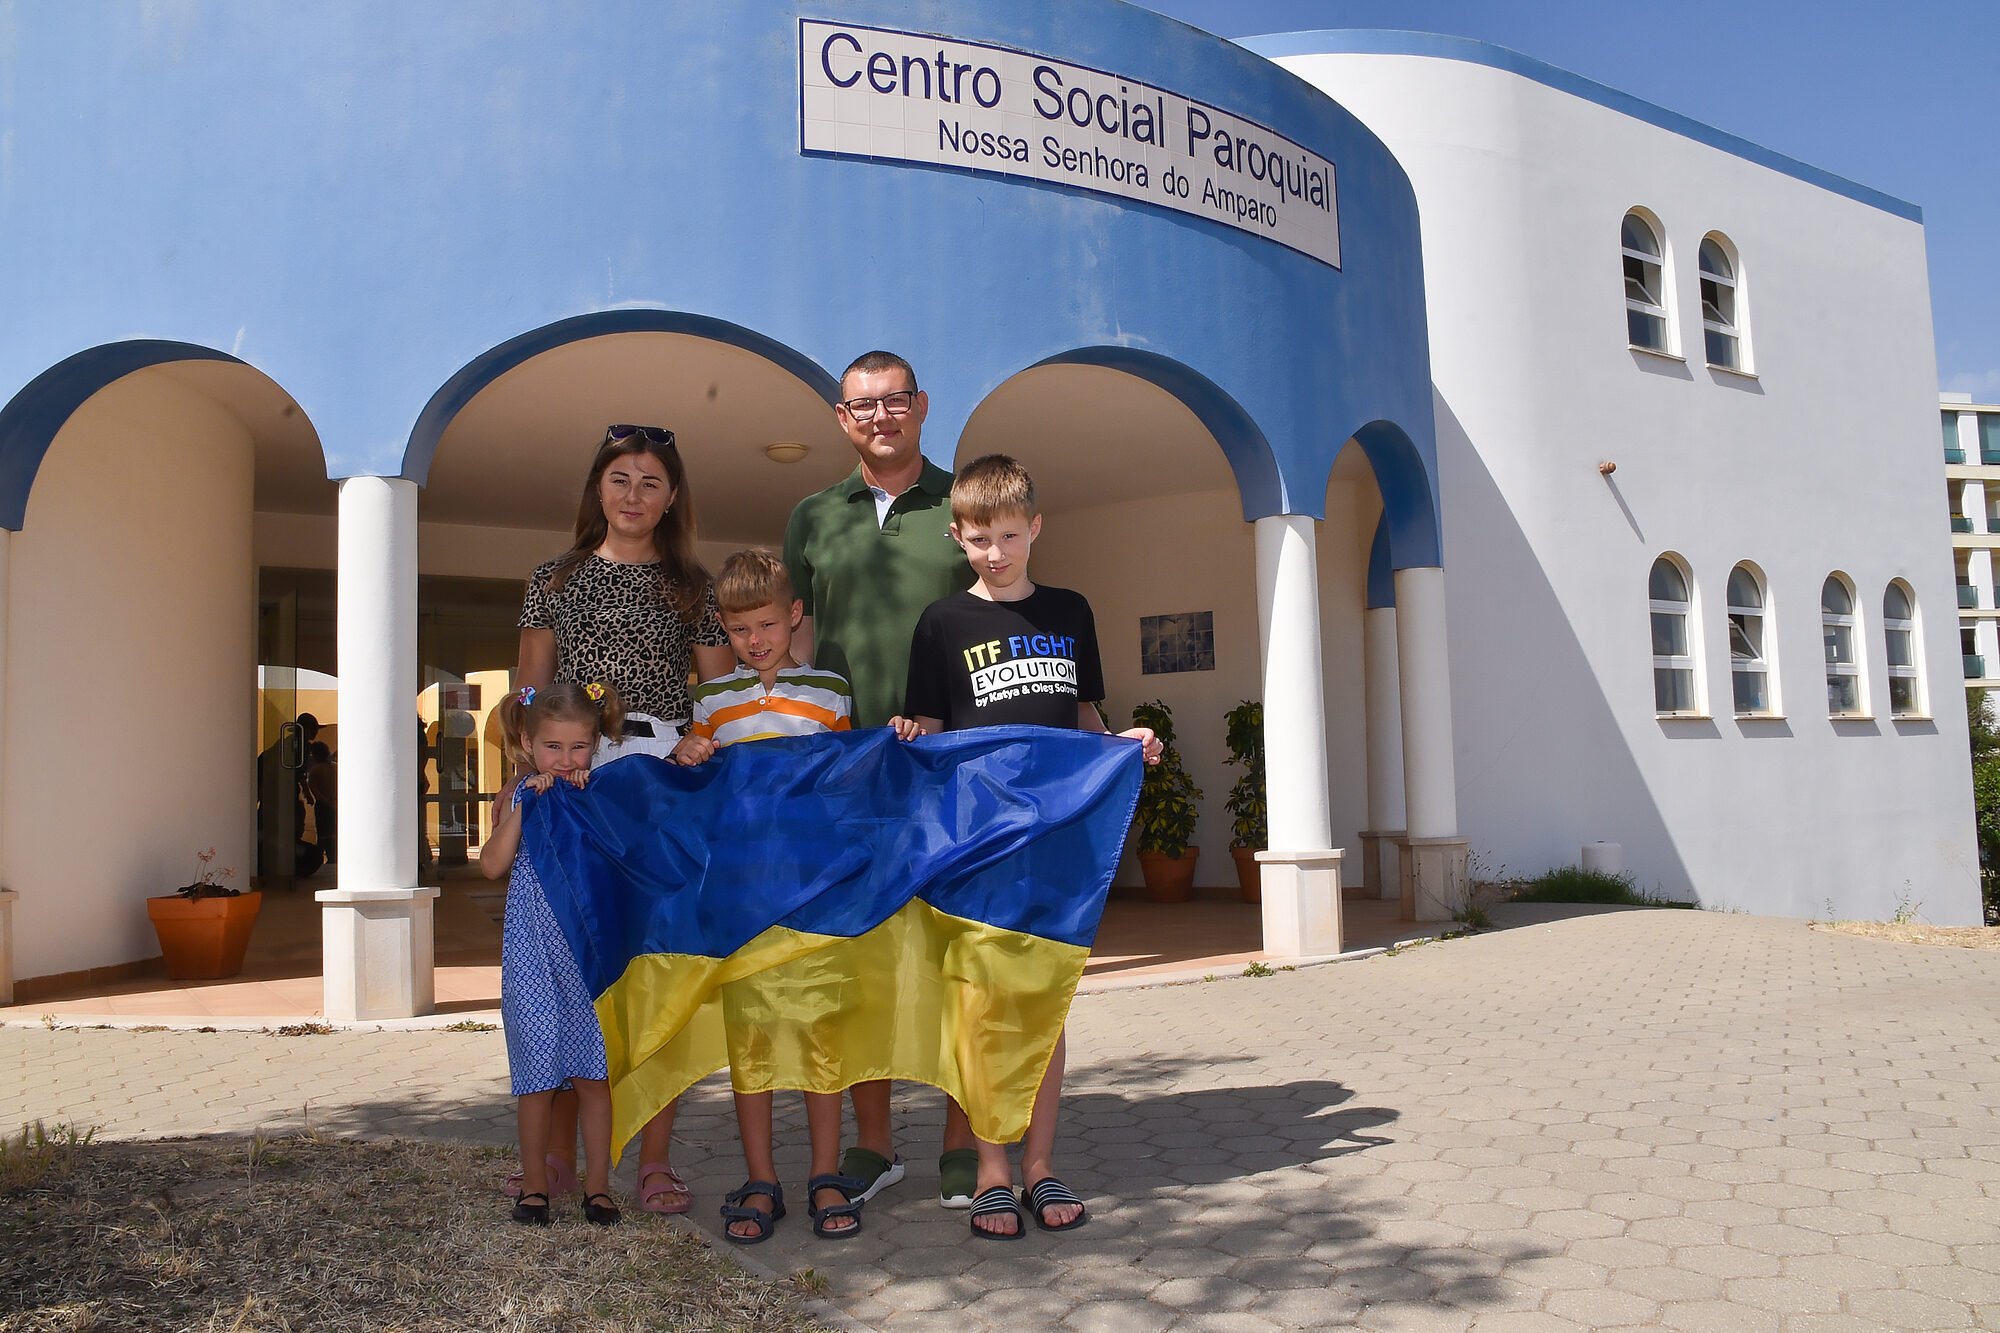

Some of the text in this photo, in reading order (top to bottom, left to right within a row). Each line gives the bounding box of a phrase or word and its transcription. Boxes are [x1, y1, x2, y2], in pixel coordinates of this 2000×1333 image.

[821, 32, 1331, 213] Centro Social Paroquial
[938, 119, 1277, 228] Nossa Senhora do Amparo
[963, 634, 1076, 673] ITF FIGHT
[975, 661, 1075, 692] EVOLUTION
[975, 696, 988, 708] by
[988, 687, 1020, 703] Katya
[1021, 684, 1031, 695] &
[1031, 682, 1055, 695] Oleg
